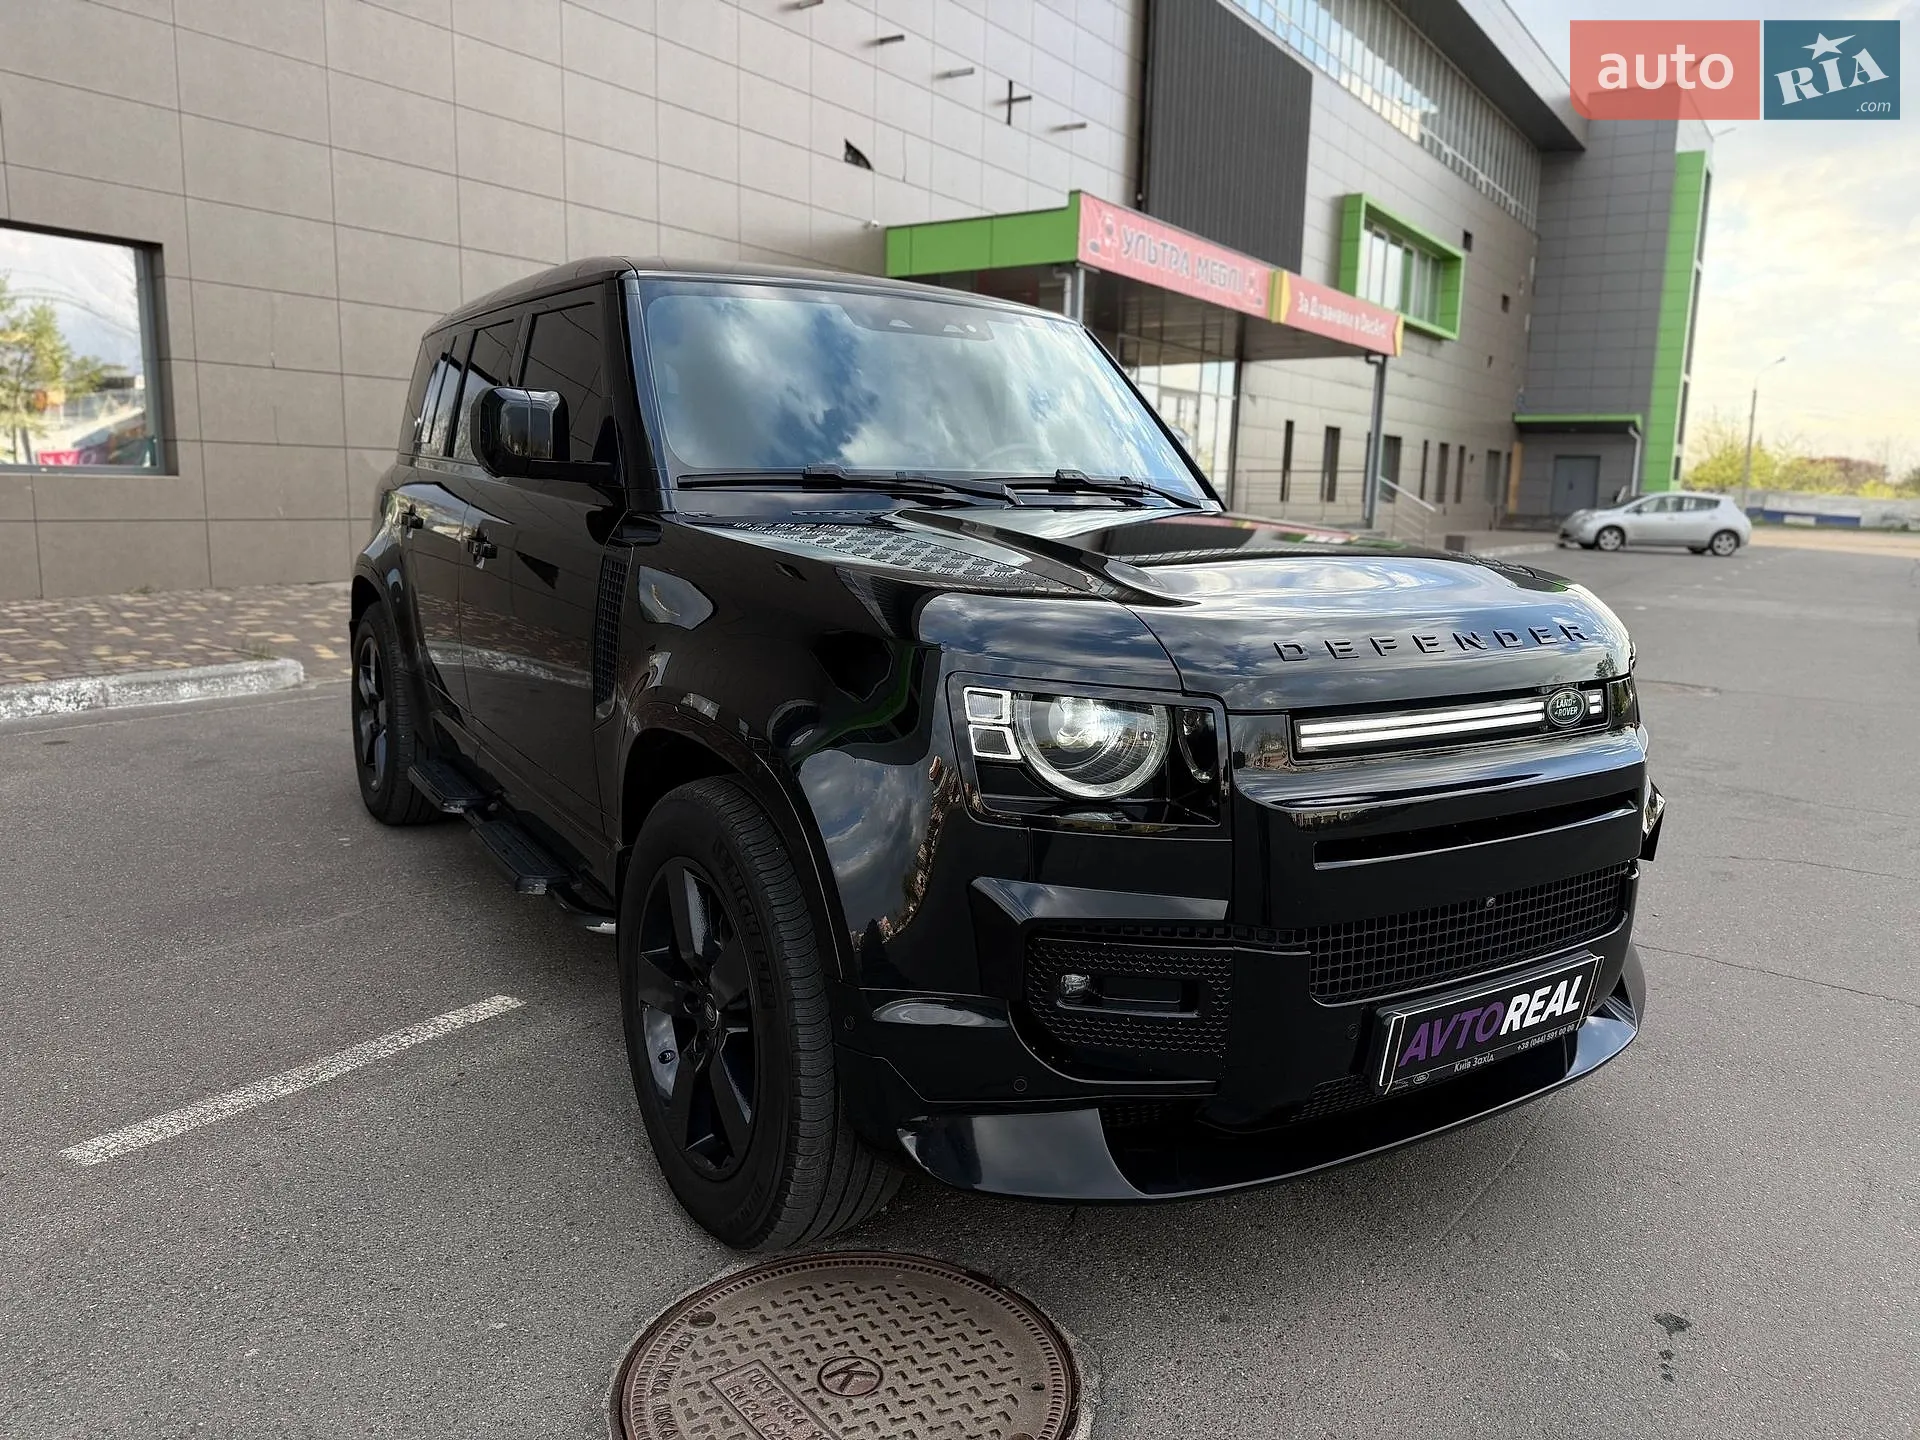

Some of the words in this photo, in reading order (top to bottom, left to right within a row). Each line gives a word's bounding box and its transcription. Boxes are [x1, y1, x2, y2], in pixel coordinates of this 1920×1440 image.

[1121, 225, 1190, 277] УЛЬТРА
[1273, 624, 1589, 662] DEFENDER
[1556, 698, 1573, 709] LAND
[1558, 706, 1578, 717] ROVER
[1517, 1041, 1530, 1051] +38
[1454, 1060, 1471, 1073] Київ
[1472, 1052, 1495, 1067] Захід
